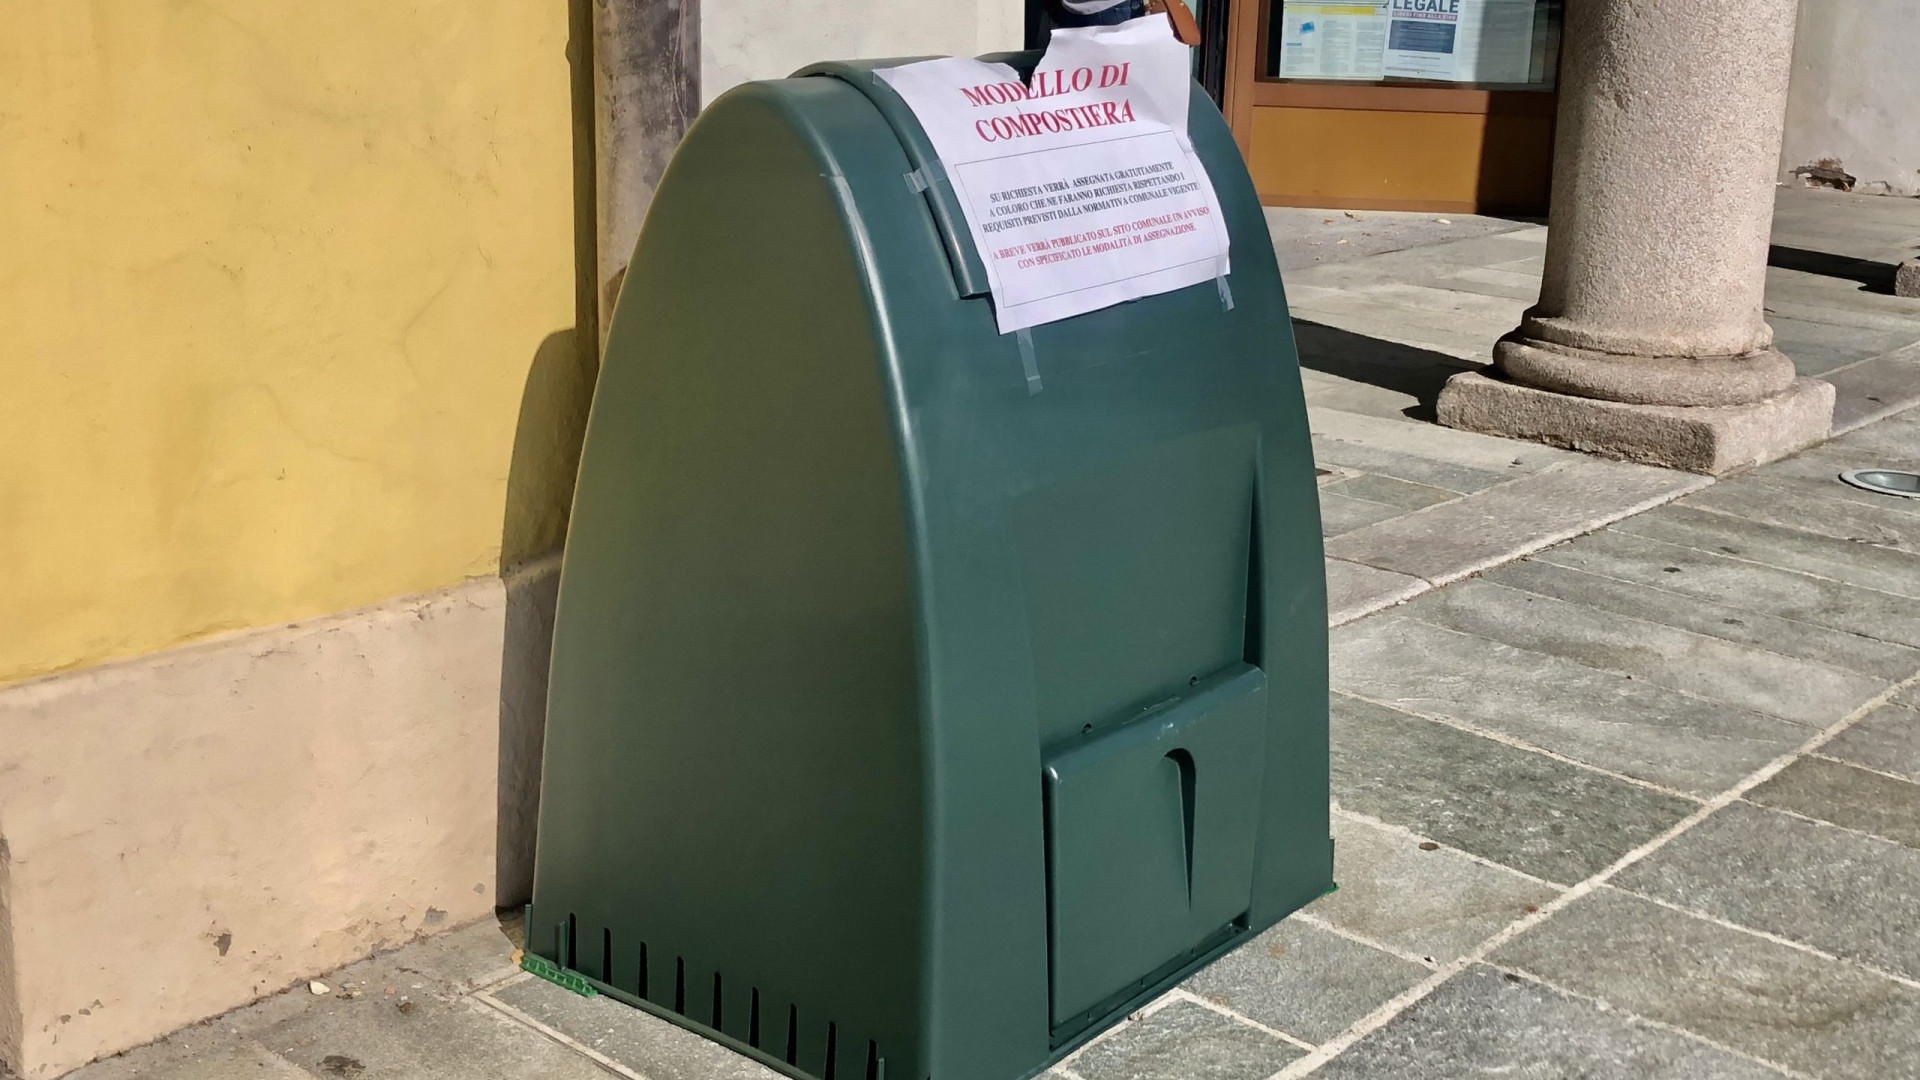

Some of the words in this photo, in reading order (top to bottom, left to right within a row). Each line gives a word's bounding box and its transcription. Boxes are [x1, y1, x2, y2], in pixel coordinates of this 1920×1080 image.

[1392, 0, 1459, 13] LEGALE
[959, 67, 1093, 107] MODELLO
[1097, 62, 1131, 89] DI
[975, 99, 1136, 143] COMPOSTIERA
[990, 192, 1001, 203] SU
[1001, 185, 1043, 202] RICHIESTA
[1043, 178, 1070, 193] VERRÀ
[1072, 172, 1114, 188] ASSEGNATA
[1114, 161, 1175, 180] GRATUITAMENTE
[990, 208, 996, 218] A
[995, 201, 1029, 216] COLORO
[1029, 199, 1047, 210] CHE
[1046, 196, 1059, 207] NE
[1059, 189, 1094, 205] FARANNO
[1093, 183, 1133, 198] RICHIESTA
[1133, 173, 1181, 190] RISPETTANDO
[982, 217, 1024, 234] REQUISITI
[1022, 210, 1058, 226] PREVISTI
[1056, 206, 1083, 219] DALLA
[1082, 197, 1129, 214] NORMATIVA
[1128, 188, 1169, 204] COMUNALE
[1167, 181, 1201, 196] VIGENTE
[992, 251, 999, 261] A
[999, 245, 1026, 259] BREVE
[1026, 238, 1052, 253] VERRÀ
[1050, 230, 1097, 249] PUBBLICATO
[1096, 227, 1113, 239] SUL
[1112, 223, 1132, 236] SITO
[1131, 216, 1173, 231] COMUNALE
[1171, 212, 1183, 223] UN
[1182, 206, 1210, 220] AVVISO
[1017, 258, 1036, 270] CON
[1035, 248, 1081, 266] SPECIFICATO
[1081, 245, 1093, 257] LE
[1092, 235, 1133, 254] MODALITÀ
[1132, 234, 1143, 245] DI
[1142, 222, 1197, 243] ASSEGNAZIONE
